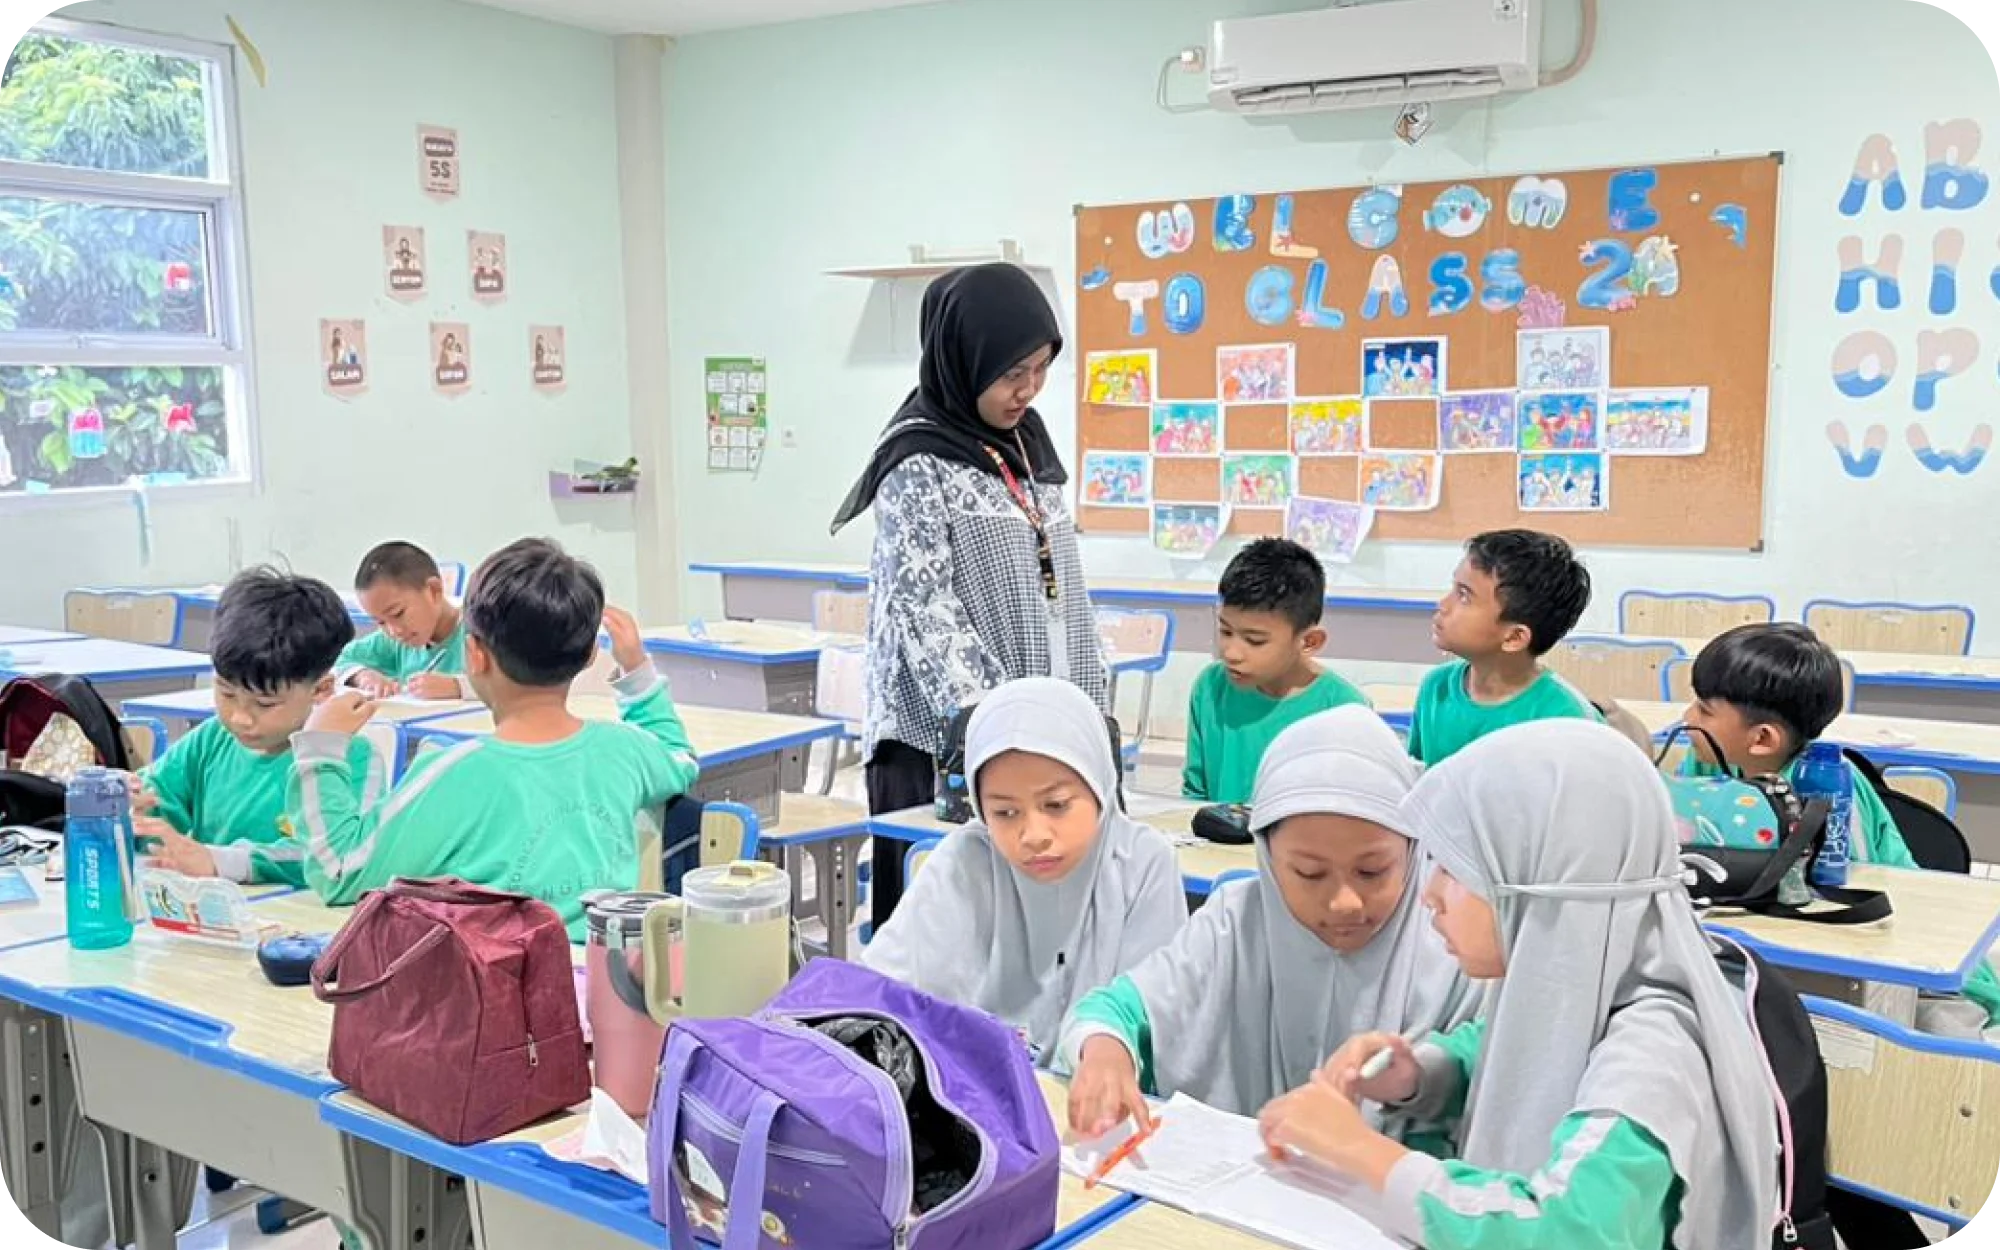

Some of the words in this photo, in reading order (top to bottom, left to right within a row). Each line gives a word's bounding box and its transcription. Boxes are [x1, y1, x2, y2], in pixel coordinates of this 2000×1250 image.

[429, 159, 452, 179] 5S
[1112, 271, 1206, 335] TO
[1245, 247, 1526, 328] CLASS
[84, 846, 100, 911] SPORTS
